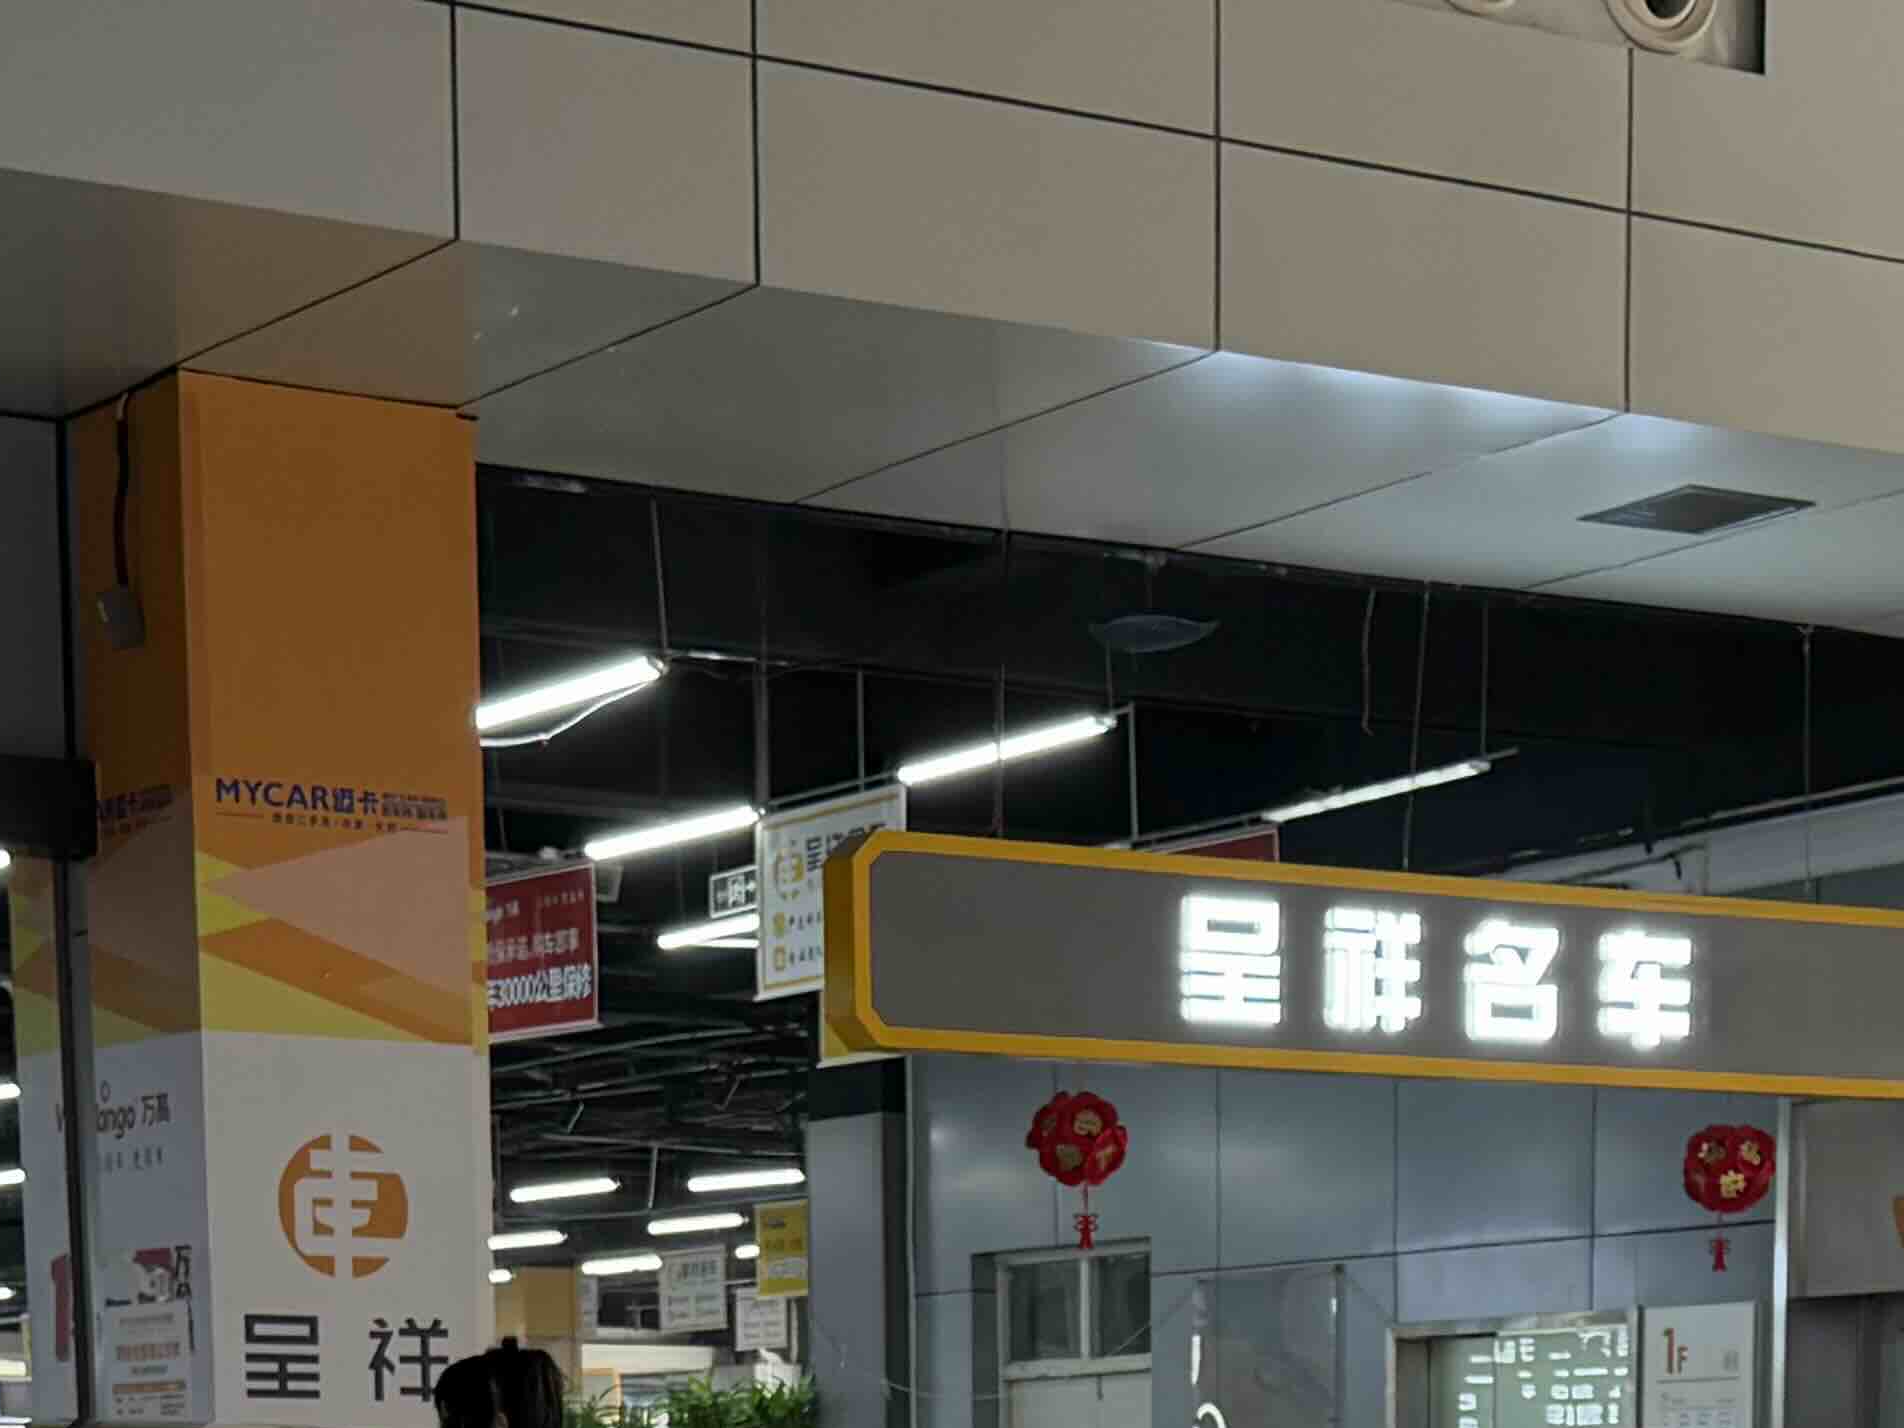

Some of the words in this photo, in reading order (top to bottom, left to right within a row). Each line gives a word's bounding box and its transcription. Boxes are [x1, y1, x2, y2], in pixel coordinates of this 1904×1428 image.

[1180, 894, 1691, 1049] 呈祥名车
[244, 1312, 451, 1402] 呈祥
[1663, 1328, 1688, 1374] 1F
